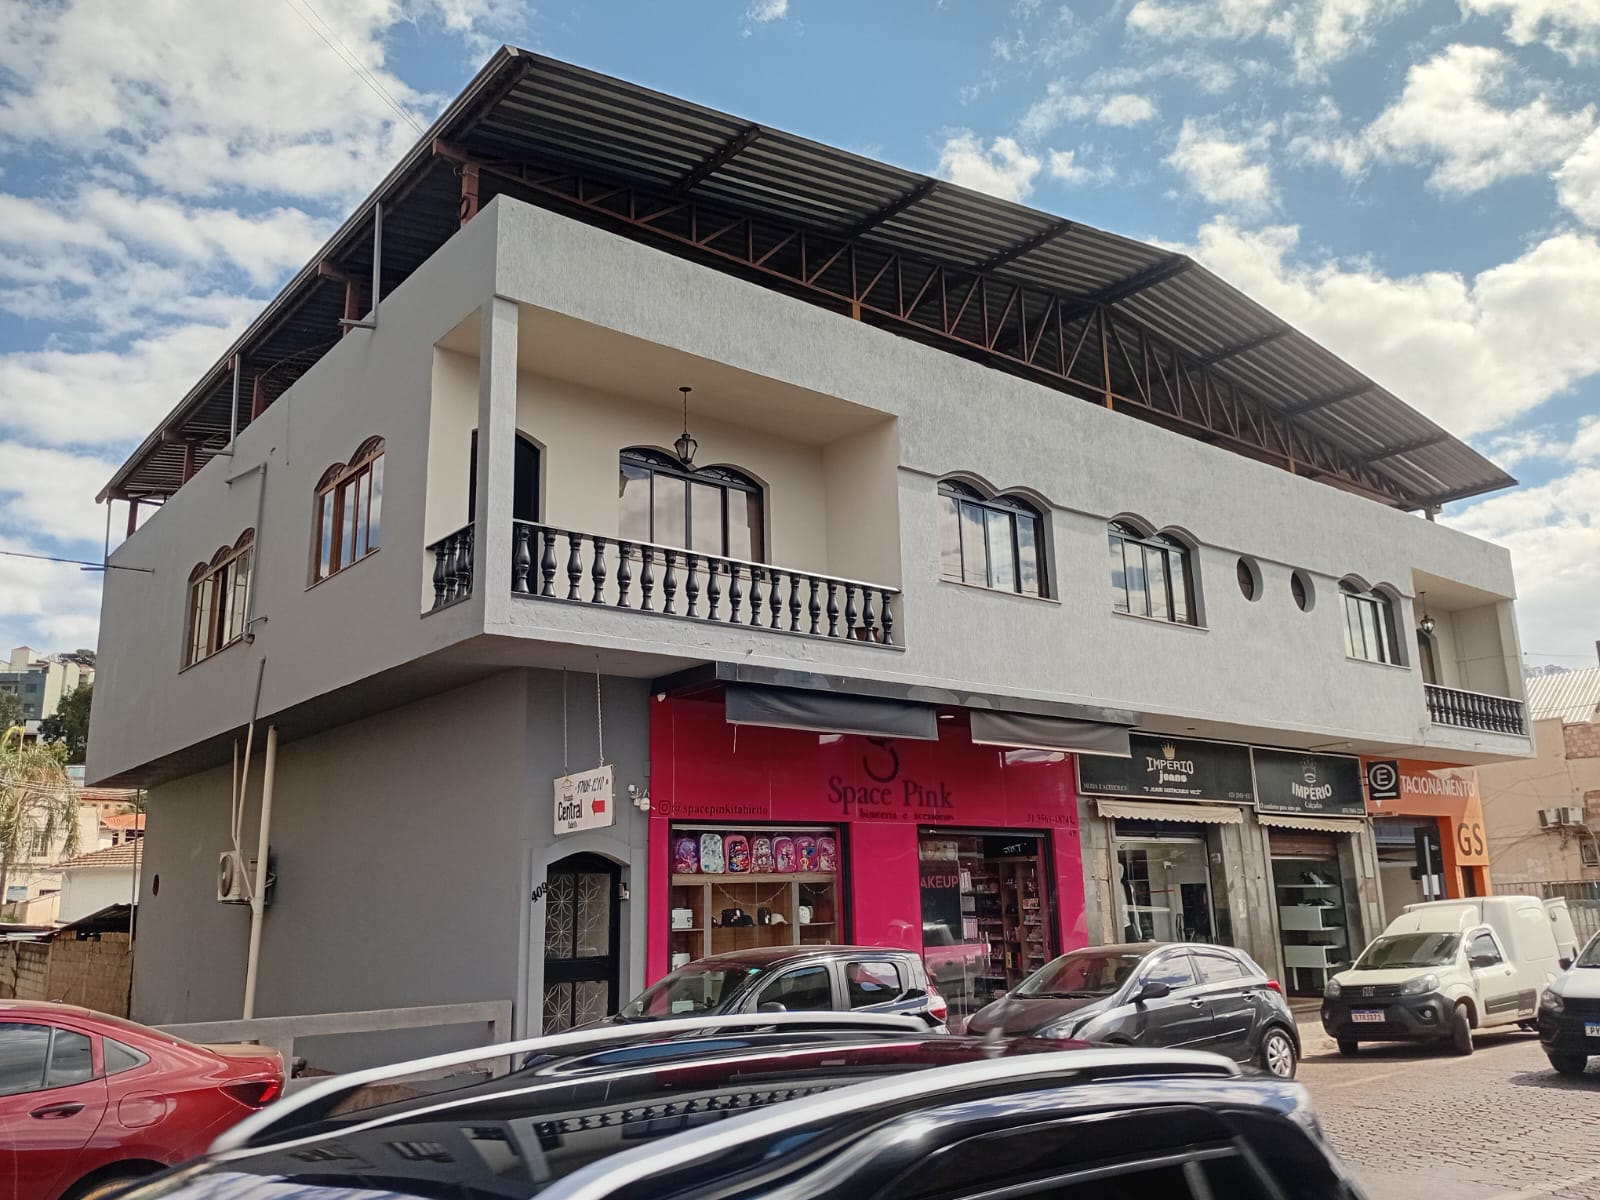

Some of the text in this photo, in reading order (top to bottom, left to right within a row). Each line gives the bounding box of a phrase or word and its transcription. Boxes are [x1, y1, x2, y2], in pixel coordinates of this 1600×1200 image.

[1146, 756, 1194, 775] IMPERIO
[1376, 769, 1389, 785] E
[1400, 775, 1476, 798] TACIONAMENTO
[827, 775, 955, 815] Space Pink
[1291, 782, 1333, 801] IMPÉRIO
[557, 798, 583, 822] Central
[1457, 822, 1484, 856] GS
[920, 875, 959, 889] AKEUP
